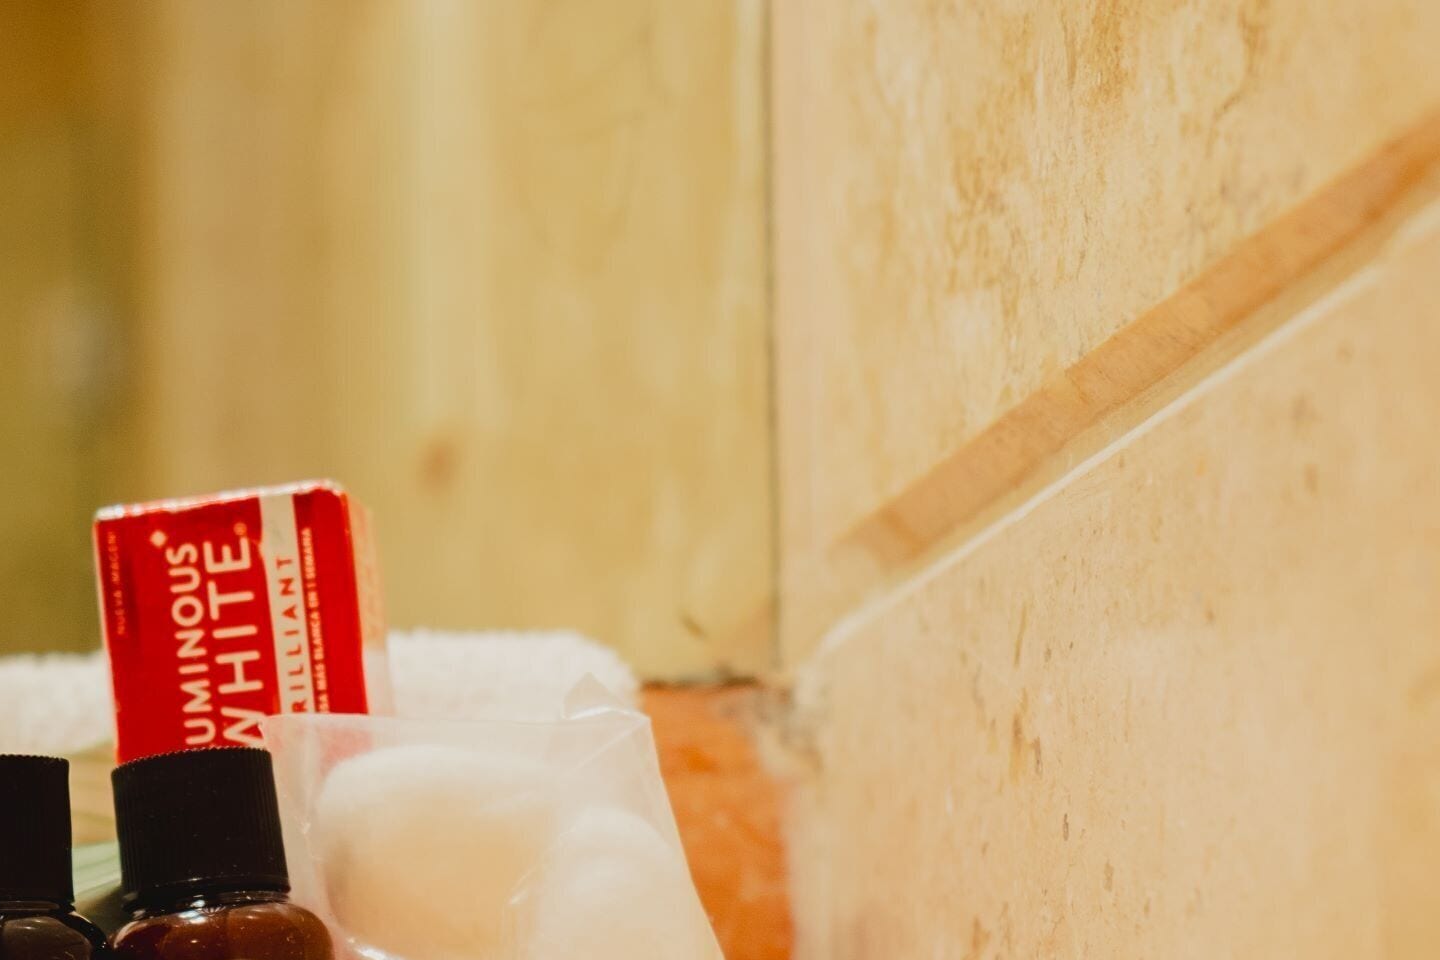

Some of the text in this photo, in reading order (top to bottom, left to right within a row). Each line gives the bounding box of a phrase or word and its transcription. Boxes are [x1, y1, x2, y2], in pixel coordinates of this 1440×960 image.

[301, 527, 316, 579] SEMANA
[308, 590, 319, 608] EN
[165, 543, 216, 745] UMINOUS
[276, 556, 307, 713] RILLIANT
[310, 610, 324, 661] BLANCA
